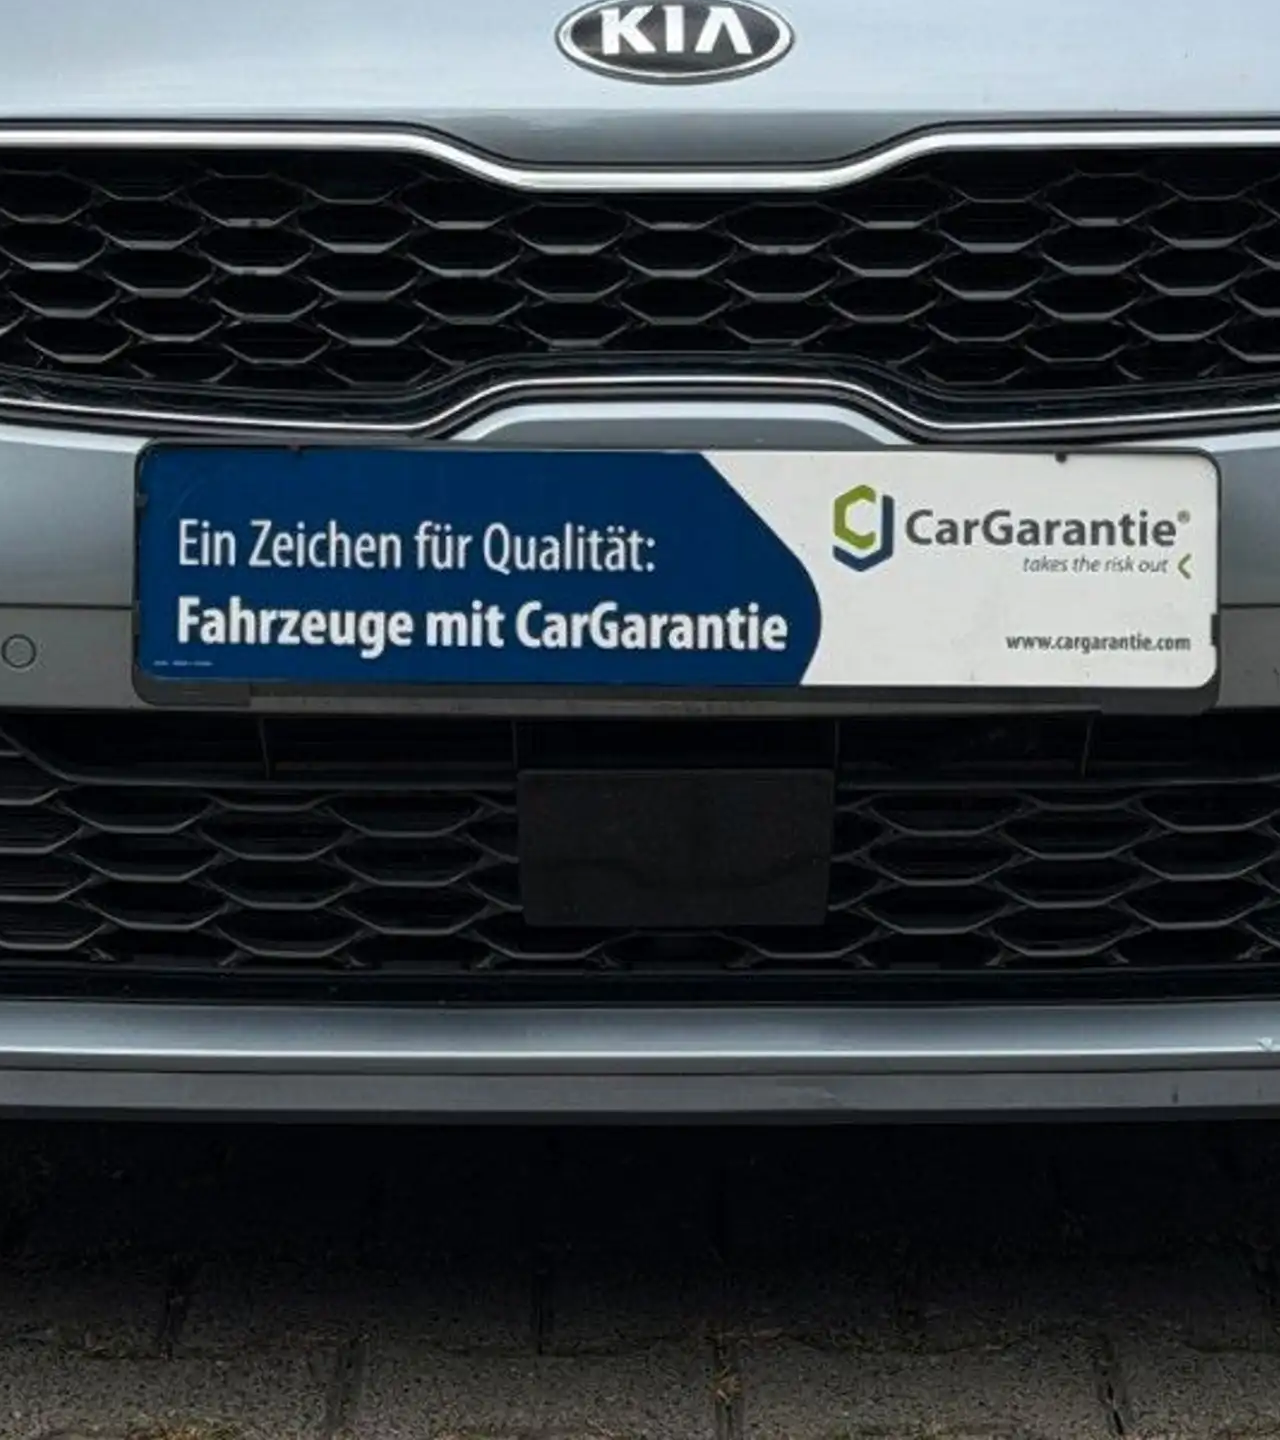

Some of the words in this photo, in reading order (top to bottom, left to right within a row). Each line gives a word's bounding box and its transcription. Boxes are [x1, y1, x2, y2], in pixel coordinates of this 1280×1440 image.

[599, 5, 753, 55] KIA
[178, 518, 236, 566] Ein
[248, 519, 402, 569] Zeichen
[414, 520, 473, 570] für
[483, 521, 656, 575] Qualität:
[1023, 555, 1068, 573] takes
[1072, 555, 1101, 573] the
[1103, 556, 1135, 573] risk
[1138, 559, 1169, 574] out
[177, 595, 414, 659] Fahrzeuge
[425, 599, 505, 648] mit
[515, 600, 789, 651] CarGarantie
[1006, 633, 1192, 655] www.cargarantie.com
